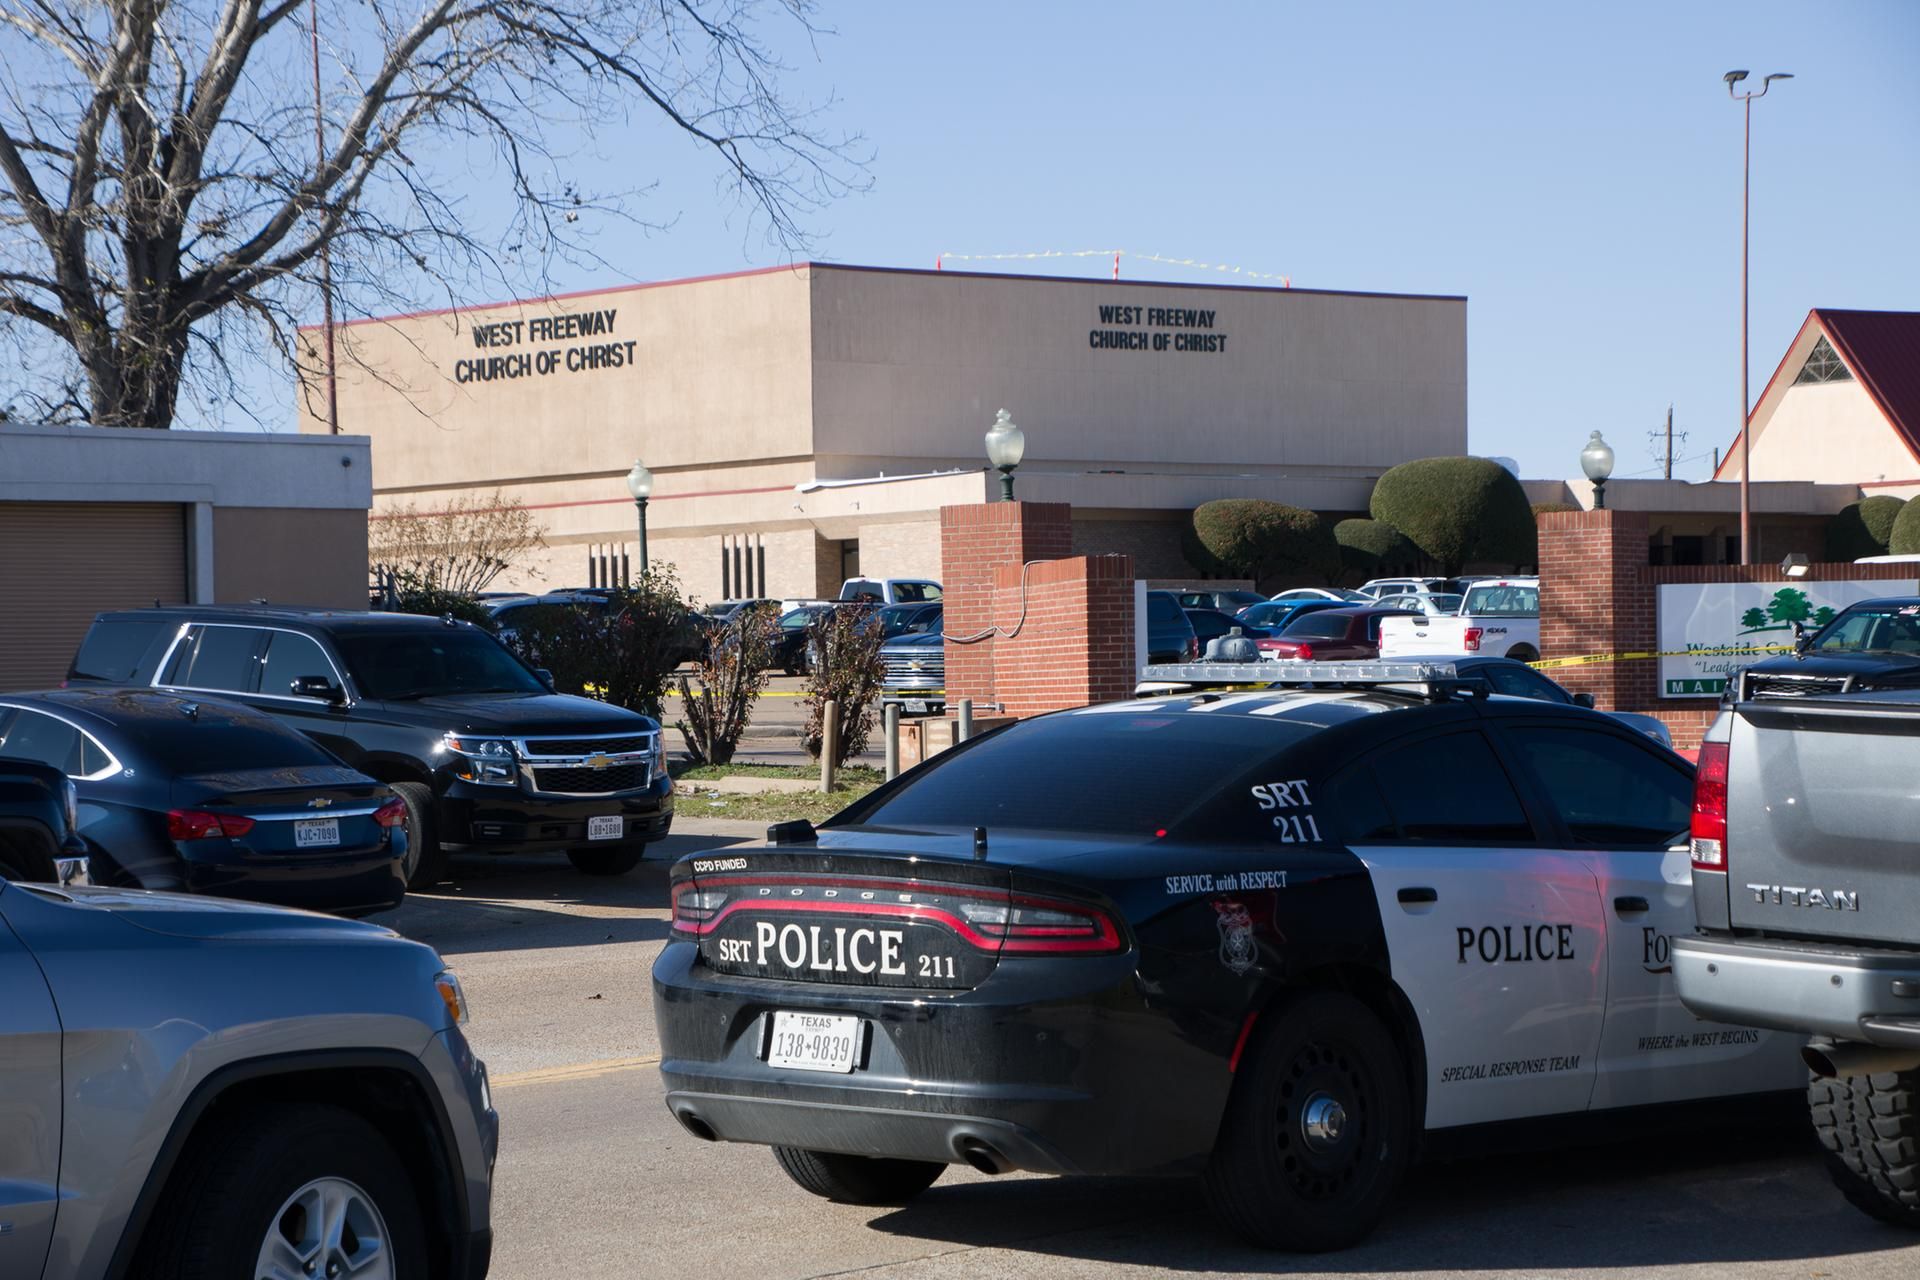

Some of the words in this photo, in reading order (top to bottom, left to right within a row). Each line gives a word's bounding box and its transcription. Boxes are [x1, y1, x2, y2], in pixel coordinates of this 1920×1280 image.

[472, 320, 524, 349] WEST
[529, 309, 617, 342] FREEWAY
[1099, 305, 1143, 325] WEST
[1147, 307, 1216, 328] FREEWAY
[1089, 330, 1148, 350] CHURCH
[1152, 332, 1171, 351] OF
[1174, 333, 1227, 353] CHRIST
[455, 350, 532, 383] CHURCH
[535, 350, 561, 376] OF
[566, 341, 637, 372] CHRIST
[1686, 641, 1760, 657] Westside
[1251, 779, 1312, 810] SRT
[1273, 814, 1323, 843] 211
[693, 860, 714, 872] CCPD
[714, 858, 748, 871] FUNDED
[759, 887, 913, 903] DODGE
[1166, 874, 1214, 894] SERVICE
[1216, 874, 1239, 891] with
[1240, 871, 1287, 890] RESPECT
[1747, 883, 1860, 912] TITAN
[719, 938, 752, 963] SRT
[756, 921, 906, 976] POLICE
[918, 954, 956, 978] 211
[1456, 924, 1575, 964] POLICE
[800, 1016, 832, 1029] TEXAS
[1638, 1035, 1676, 1050] WHERE
[1675, 1034, 1691, 1048] the
[1691, 1032, 1720, 1047] WEST
[1720, 1029, 1759, 1045] BEGINS
[1441, 1064, 1487, 1082] SPECIAL
[1489, 1057, 1548, 1078] RESPONSE
[1549, 1055, 1580, 1072] TEAM
